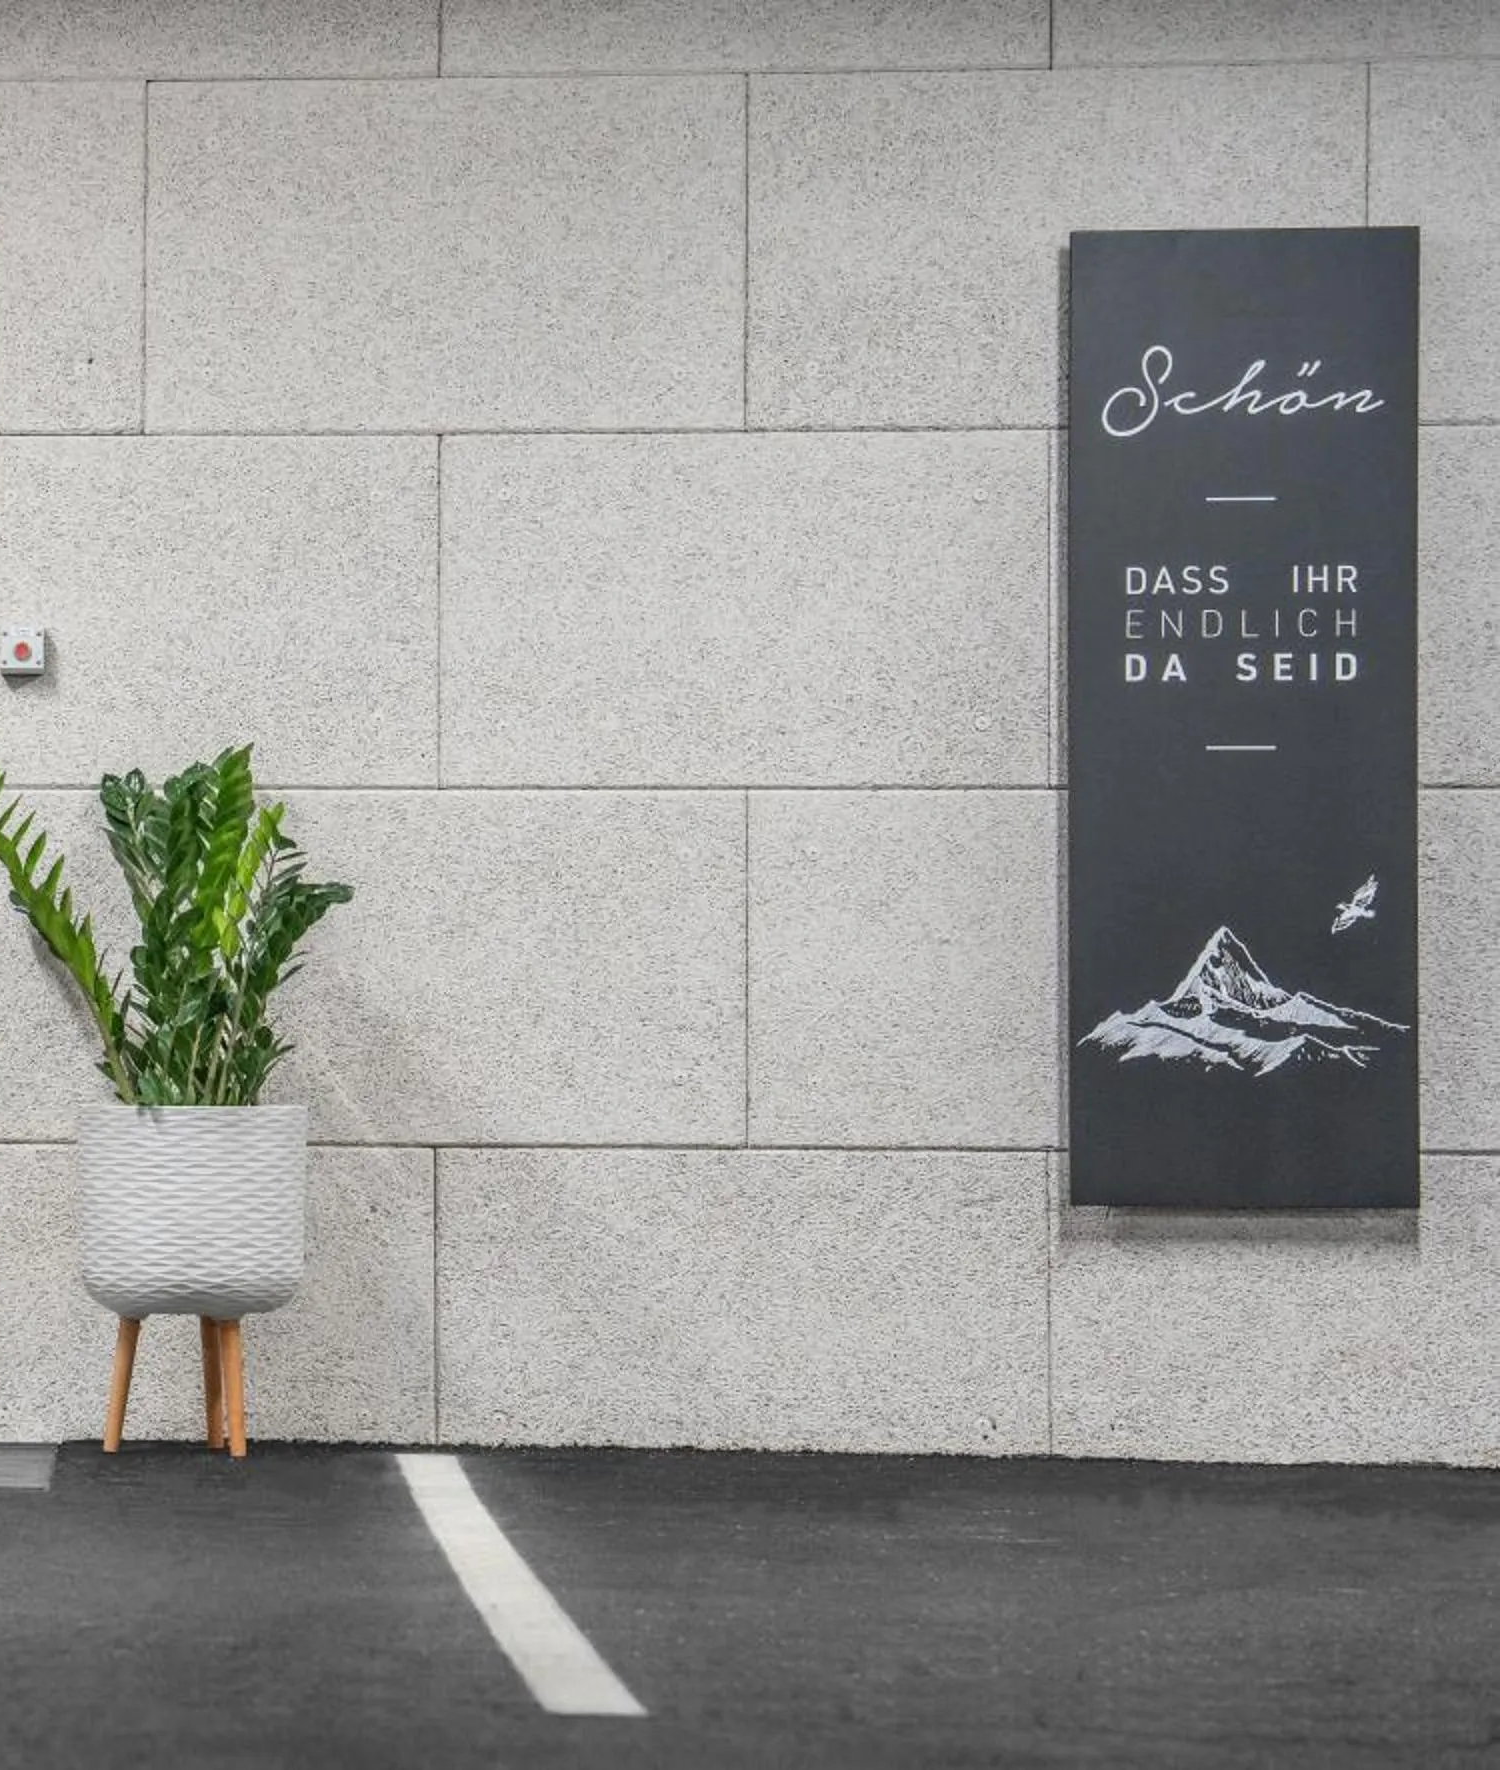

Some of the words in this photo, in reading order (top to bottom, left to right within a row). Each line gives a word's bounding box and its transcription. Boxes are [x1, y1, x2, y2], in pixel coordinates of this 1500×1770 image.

[1101, 345, 1385, 437] Schön
[1125, 565, 1230, 595] DASS
[1292, 564, 1358, 594] IHR
[1125, 608, 1357, 639] ENDLICH
[1124, 652, 1188, 683] DA
[1235, 652, 1358, 682] SEID
